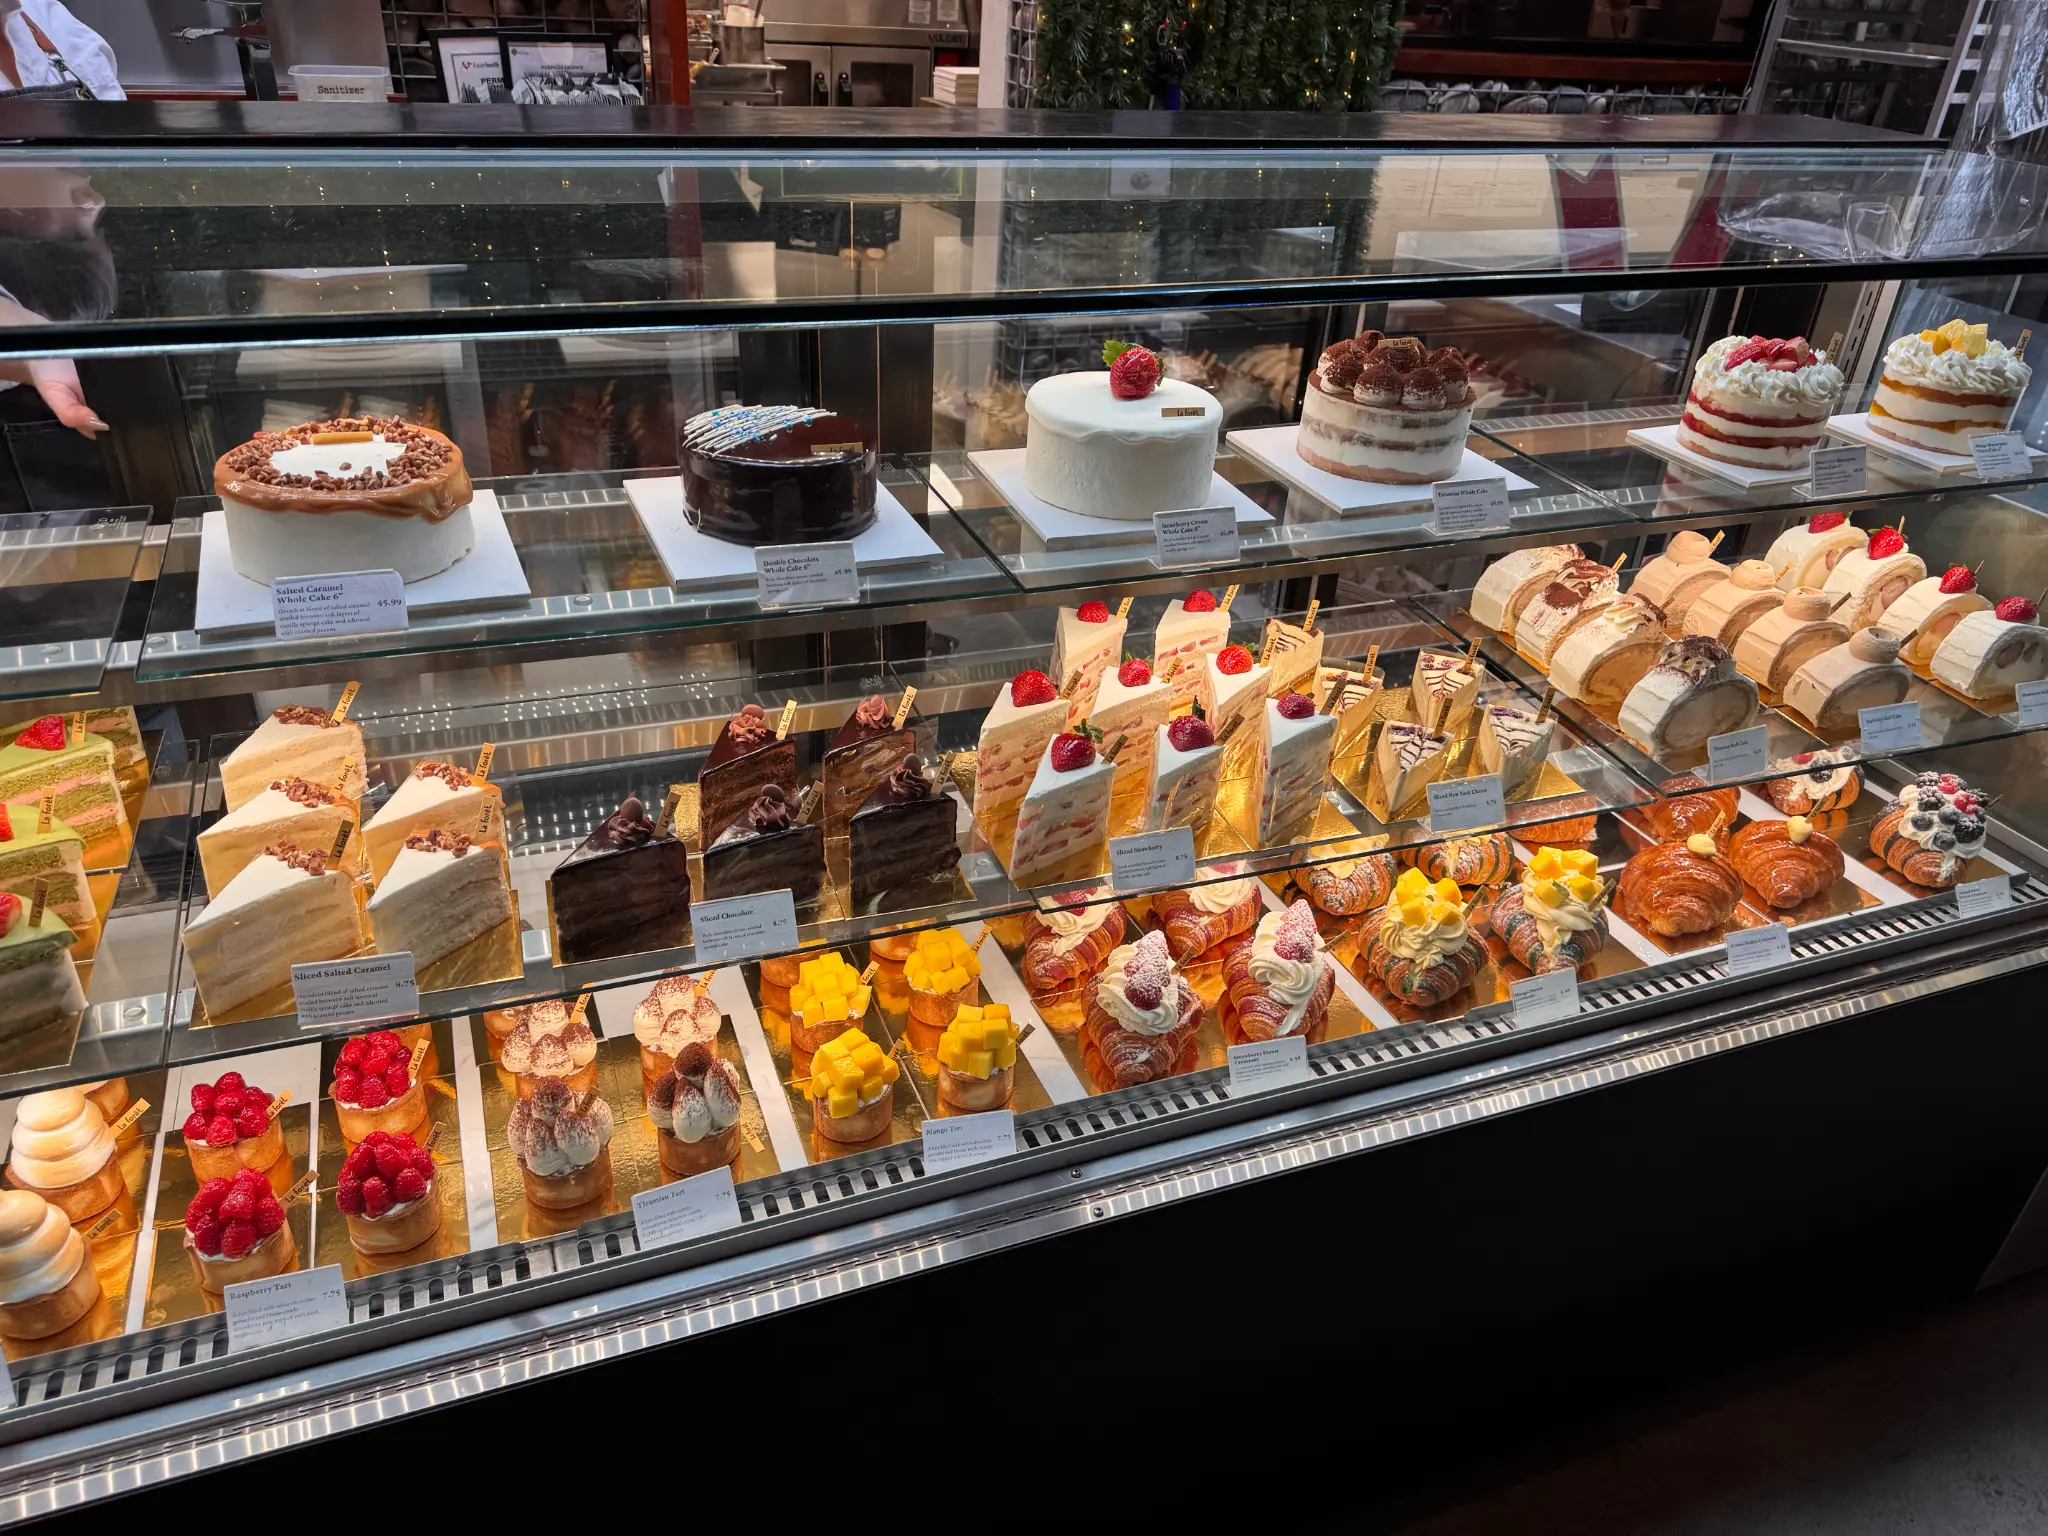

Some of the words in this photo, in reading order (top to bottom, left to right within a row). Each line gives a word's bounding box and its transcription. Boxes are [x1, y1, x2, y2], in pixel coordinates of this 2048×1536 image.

[317, 85, 365, 94] Sanitizer
[763, 559, 786, 567] Double
[787, 557, 819, 565] Chocolate
[834, 568, 852, 576] 45.99
[276, 586, 304, 595] Salted
[306, 584, 343, 593] Caramel
[277, 596, 307, 604] Whole
[309, 594, 331, 603] Cake
[377, 599, 402, 607] 45.99
[1306, 619, 1312, 627] La
[1263, 653, 1270, 661] La
[1468, 657, 1475, 665] La
[1163, 675, 1171, 684] La
[1168, 663, 1180, 677] forêt
[1366, 666, 1372, 675] La
[341, 687, 356, 706] forêt
[1065, 691, 1072, 699] La
[901, 693, 914, 711] forêt
[1328, 701, 1335, 709] La
[338, 704, 346, 714] La
[899, 709, 907, 717] La
[782, 707, 794, 724] forêt
[780, 723, 788, 732] La
[1438, 718, 1446, 727] La
[1221, 733, 1229, 741] La
[480, 751, 492, 769] forêt
[1106, 753, 1114, 762] La
[334, 781, 343, 791] La
[339, 763, 354, 783] forêt
[477, 767, 485, 778] La
[936, 774, 945, 785] La
[42, 795, 54, 814] forêt
[804, 805, 812, 814] La
[481, 804, 493, 824] forêt
[41, 815, 51, 825] La
[662, 818, 671, 828] La
[479, 823, 487, 833] La
[339, 829, 351, 849] forêt
[335, 847, 345, 858] La
[1133, 845, 1162, 853] Strawberry
[35, 889, 47, 909] forêt
[1467, 903, 1475, 912] La
[33, 909, 43, 919] La
[700, 914, 720, 922] Sliced
[721, 909, 754, 920] Chocolate
[972, 944, 980, 953] La
[976, 931, 989, 946] forêt
[295, 971, 322, 980] Sliced
[324, 968, 352, 977] Salted
[354, 964, 390, 974] Caramel
[395, 980, 415, 988] 8.75
[410, 1061, 418, 1071] La
[414, 1047, 425, 1063] forêt
[579, 1105, 587, 1113] La
[117, 1120, 127, 1131] La
[124, 1107, 145, 1124] forêt
[926, 1128, 948, 1136] Mango
[997, 1134, 1011, 1142] 7.75
[284, 1193, 295, 1204] La
[293, 1178, 313, 1196] forêt
[715, 1190, 731, 1201] 7.75
[636, 1195, 669, 1209] Tiramisu
[670, 1189, 685, 1198] Tart
[87, 1229, 98, 1240] La
[95, 1217, 116, 1233] forêt
[230, 1286, 273, 1300] Raspberry
[274, 1282, 292, 1291] Tart
[322, 1289, 341, 1299] 7.75
